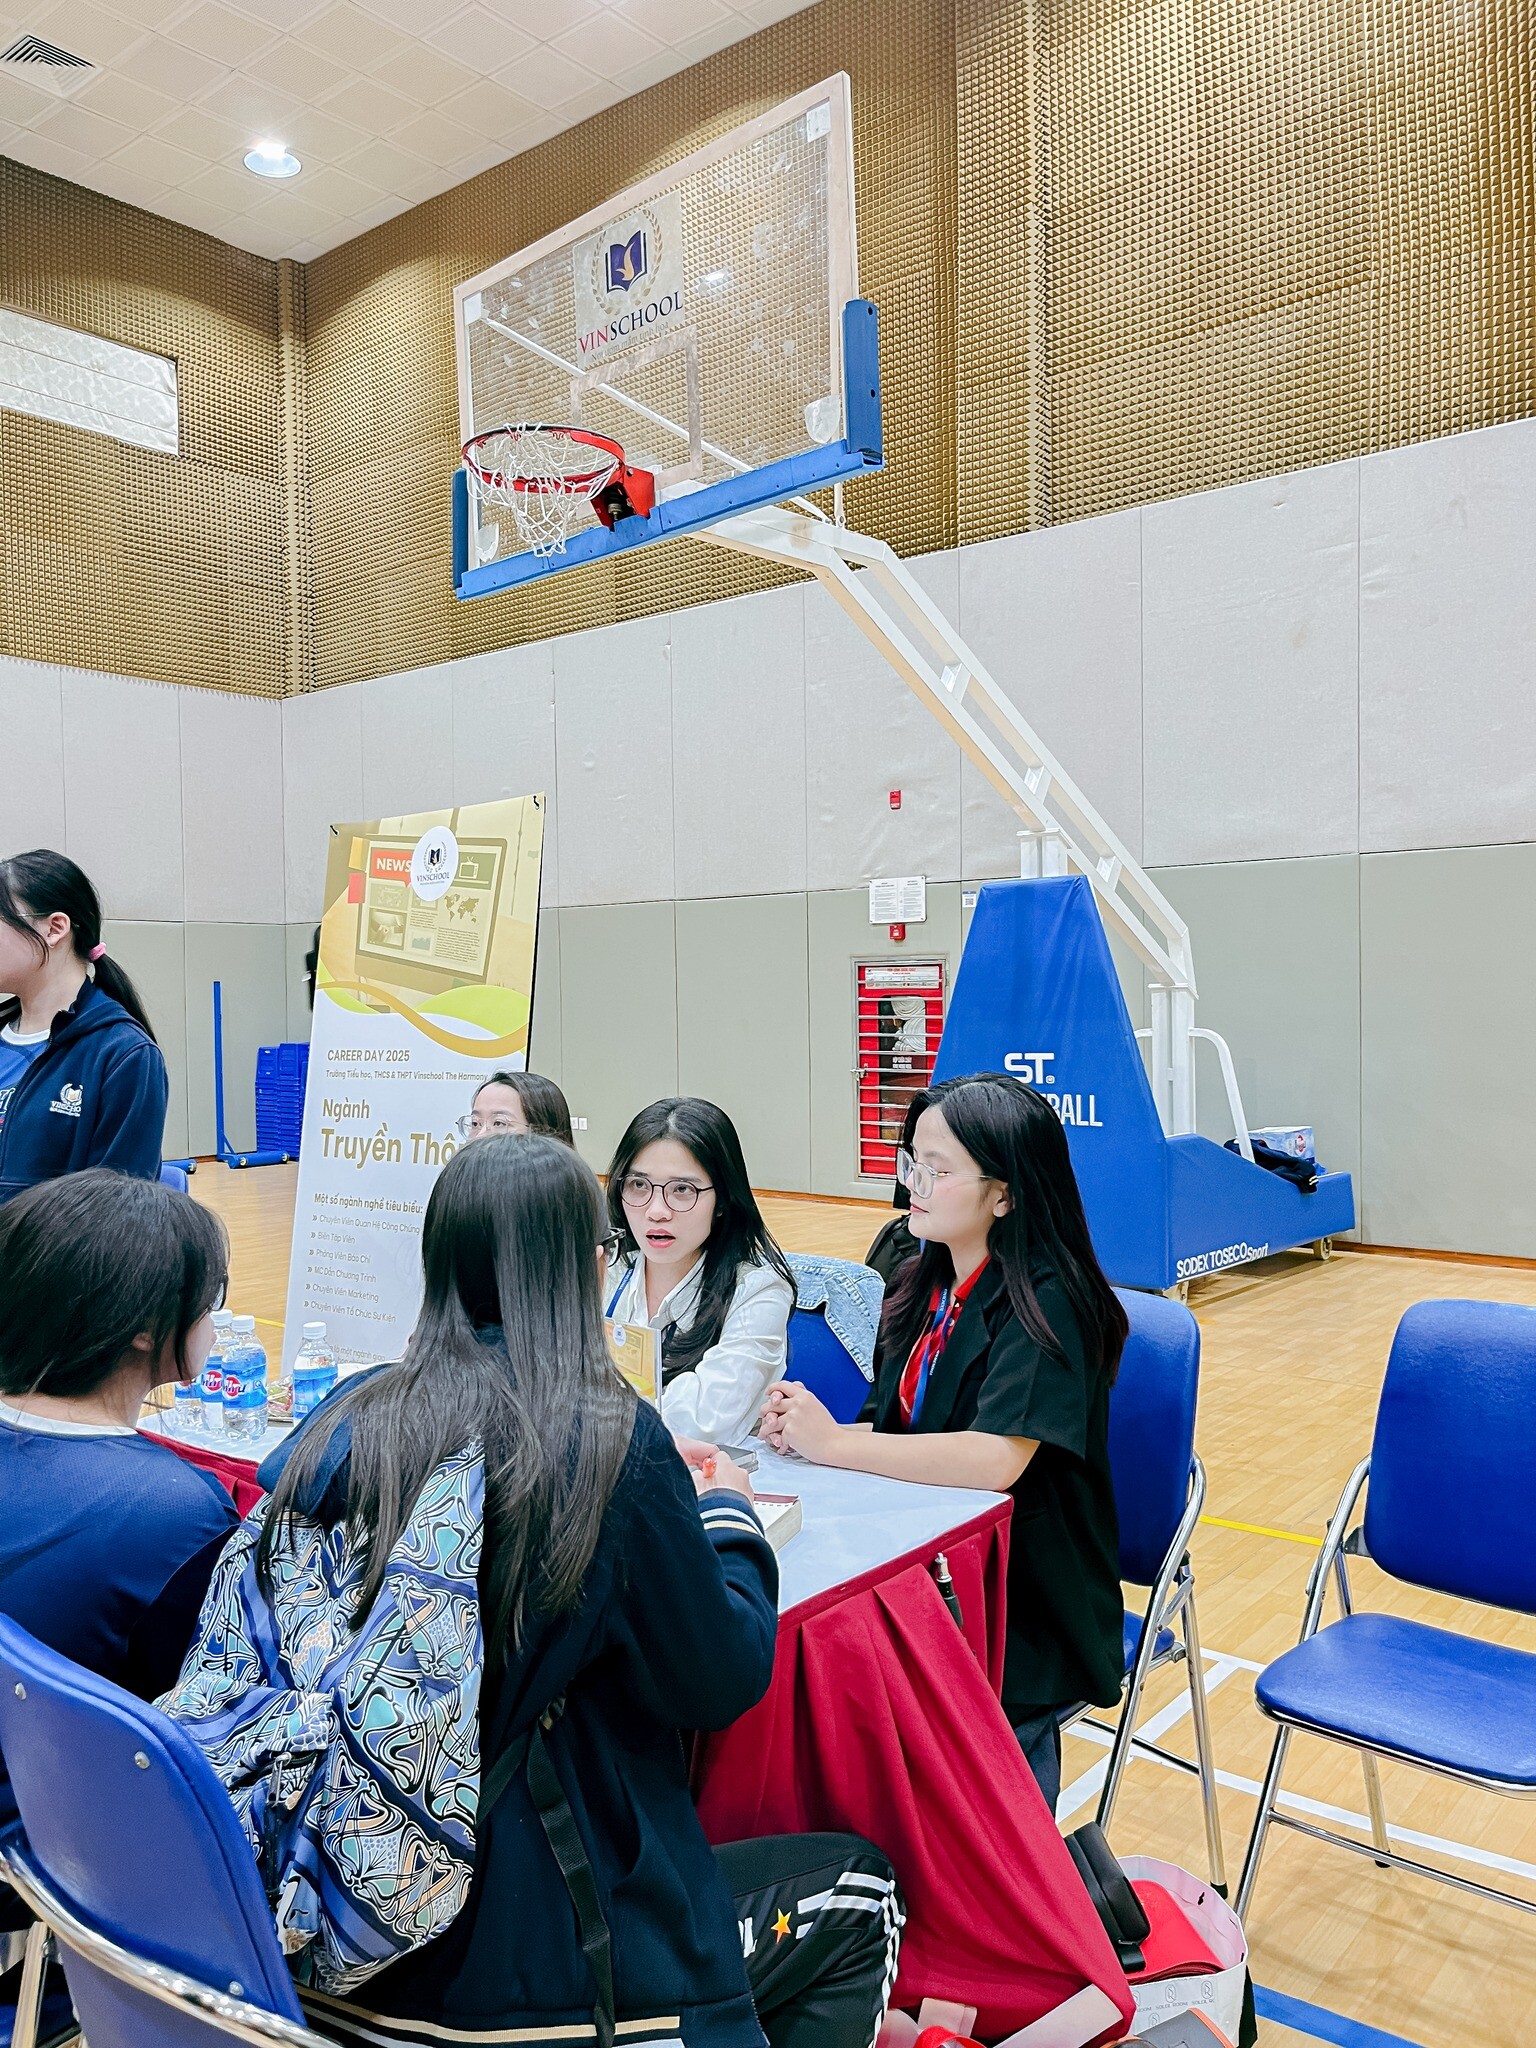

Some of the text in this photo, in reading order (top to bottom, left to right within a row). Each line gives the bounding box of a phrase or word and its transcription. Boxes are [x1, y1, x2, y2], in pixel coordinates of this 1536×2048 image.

[578, 290, 684, 354] VINSCHOOL
[376, 857, 412, 873] NEWS
[416, 871, 450, 883] VINSCHOOL
[327, 1049, 410, 1062] CAREER DAY 2025
[374, 1070, 391, 1079] THCS
[396, 1071, 412, 1079] THPT
[413, 1071, 444, 1080] Vinschool
[445, 1071, 458, 1080] The
[458, 1072, 488, 1082] Harmony
[322, 1096, 370, 1123] Ngành
[321, 1122, 402, 1169] Truyền
[314, 1192, 329, 1207] Một
[330, 1192, 340, 1205] số
[339, 1194, 363, 1209] ngành
[385, 1200, 402, 1212] tiêu
[320, 1214, 341, 1226] Chuyên
[341, 1216, 354, 1226] Viên
[354, 1218, 371, 1228] Quan
[381, 1221, 399, 1234] Công
[342, 1234, 356, 1244] Viên
[334, 1250, 347, 1261] Viên
[1176, 1253, 1209, 1279] SODEX
[1209, 1241, 1248, 1268] TOSECO
[314, 1266, 324, 1275] MC
[312, 1283, 379, 1303] Chuyên Viên Marketing
[310, 1300, 332, 1313] Chuyên
[332, 1303, 346, 1314] Viên
